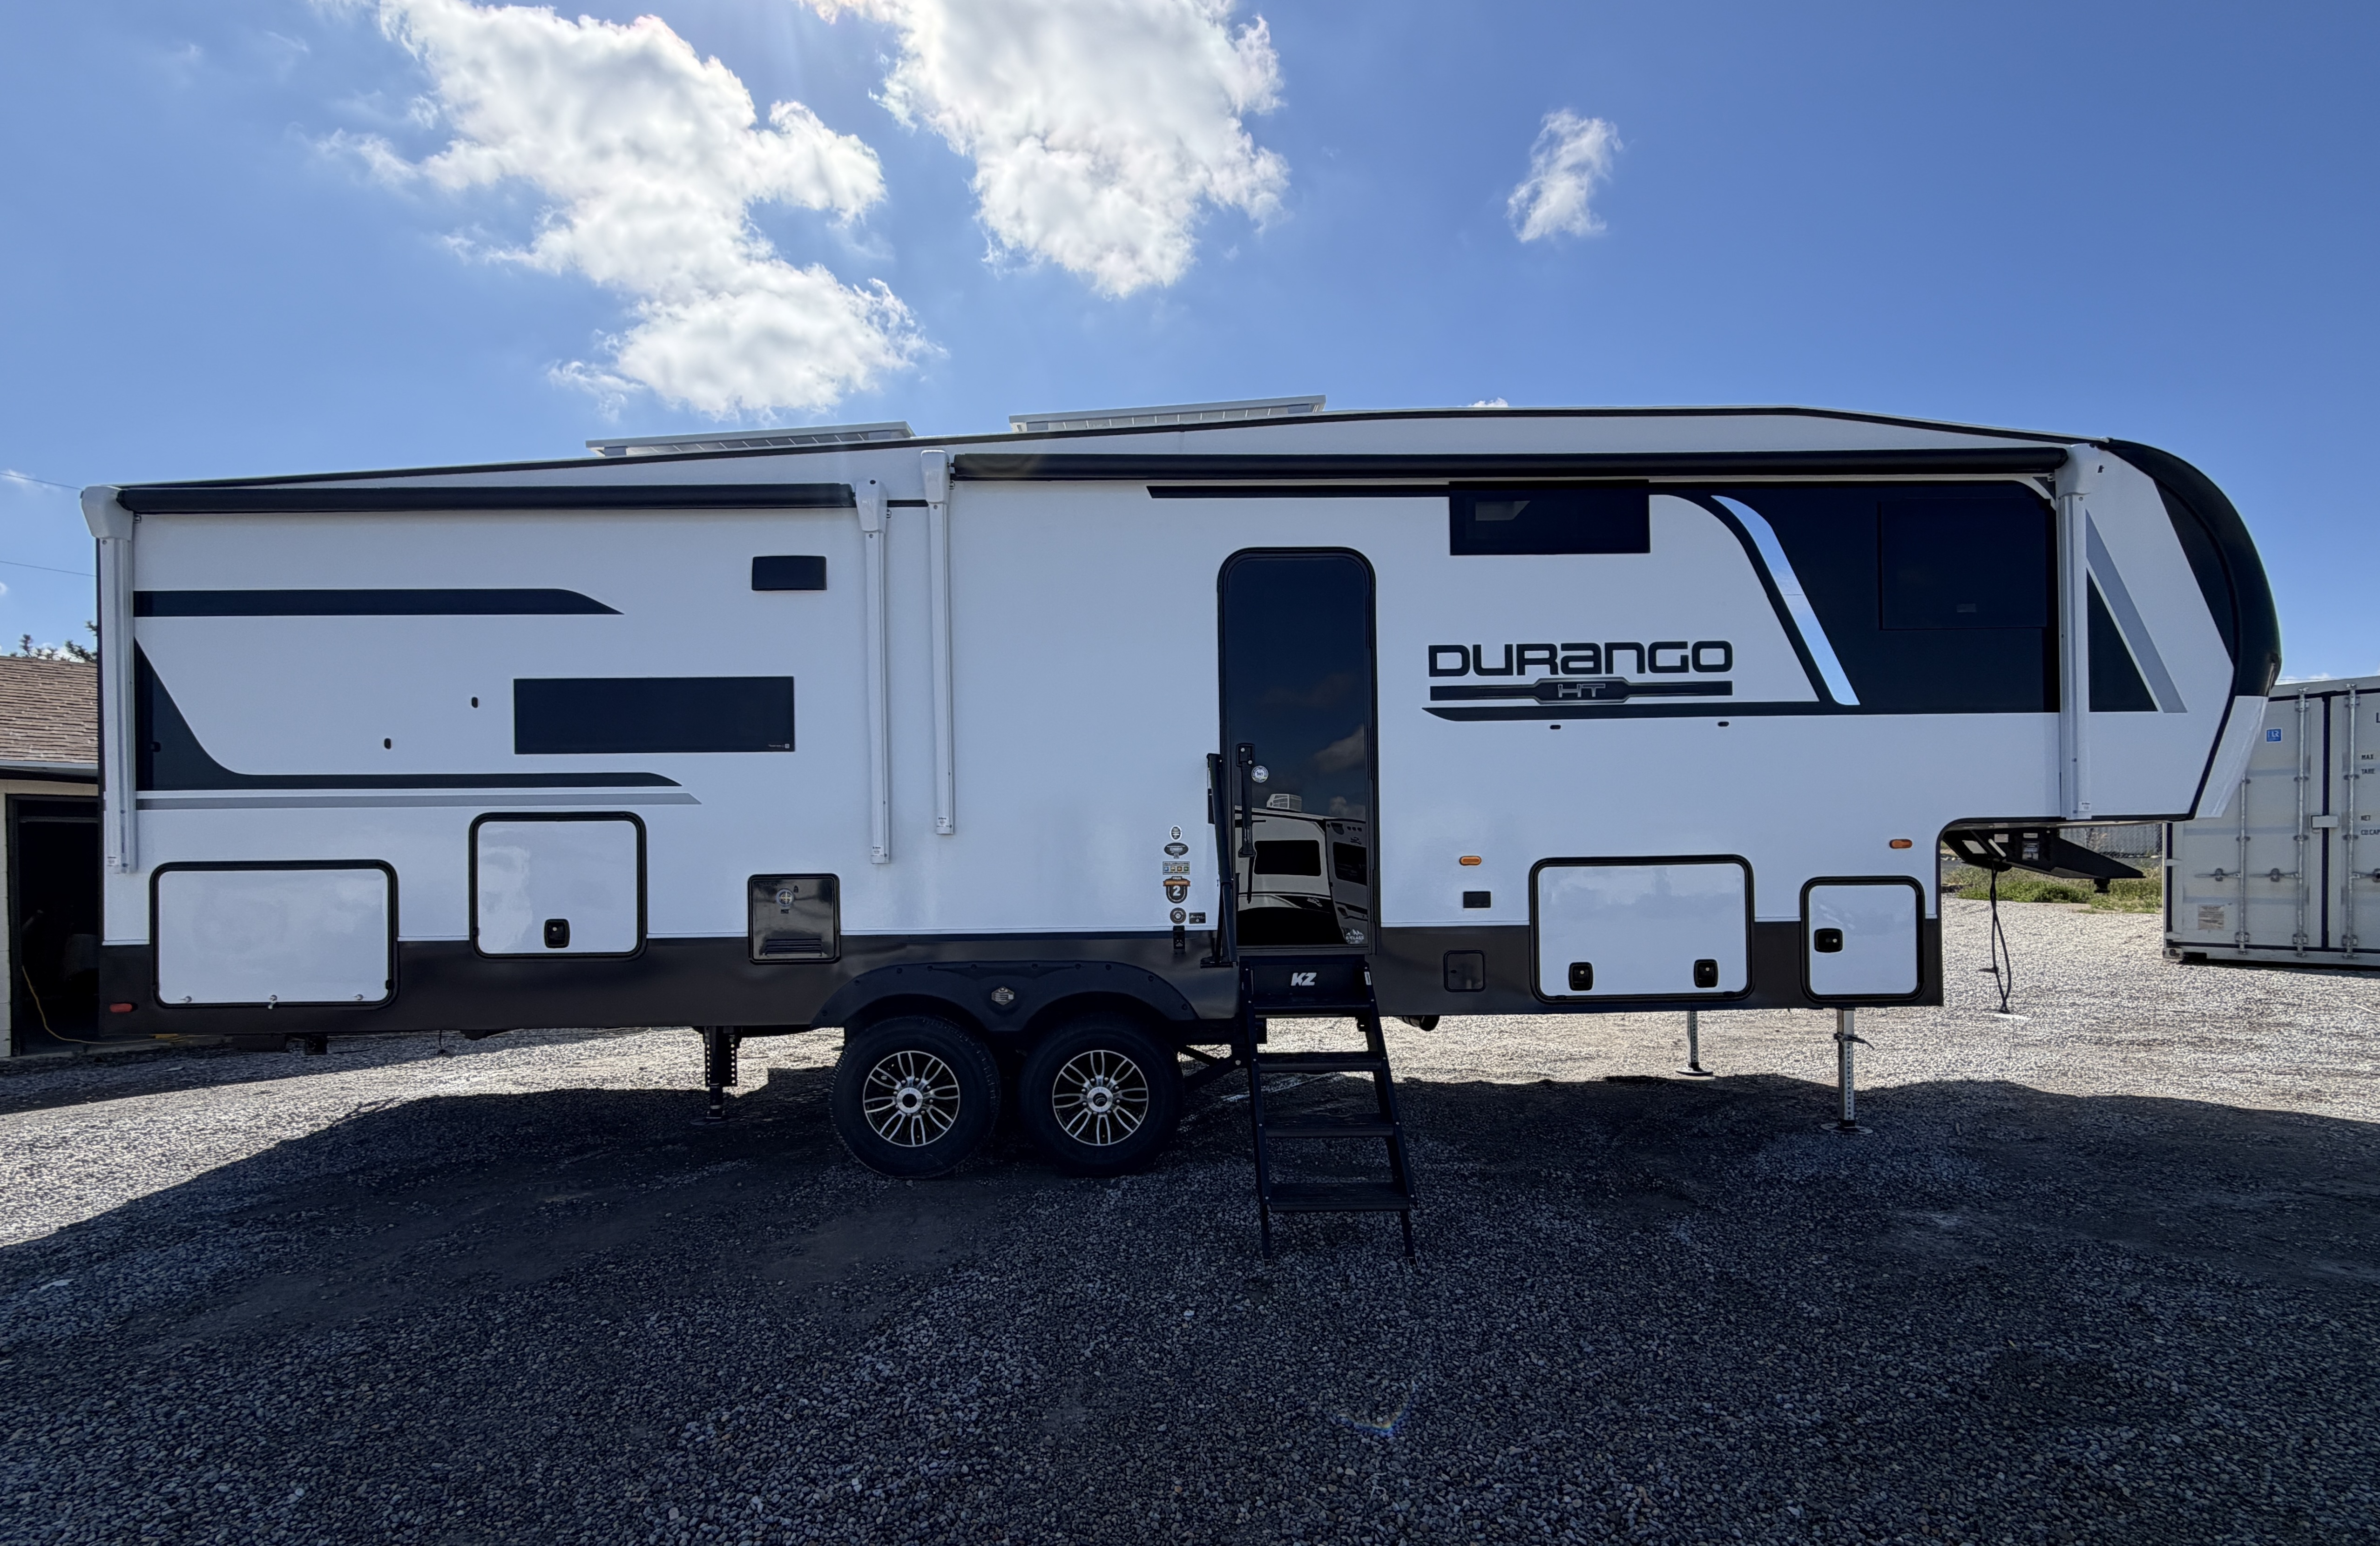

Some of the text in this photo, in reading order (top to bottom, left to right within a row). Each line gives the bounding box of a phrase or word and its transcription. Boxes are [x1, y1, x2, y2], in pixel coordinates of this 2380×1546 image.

[1558, 683, 1606, 698] HT
[1173, 885, 1181, 896] 2
[1291, 972, 1317, 986] KZ
